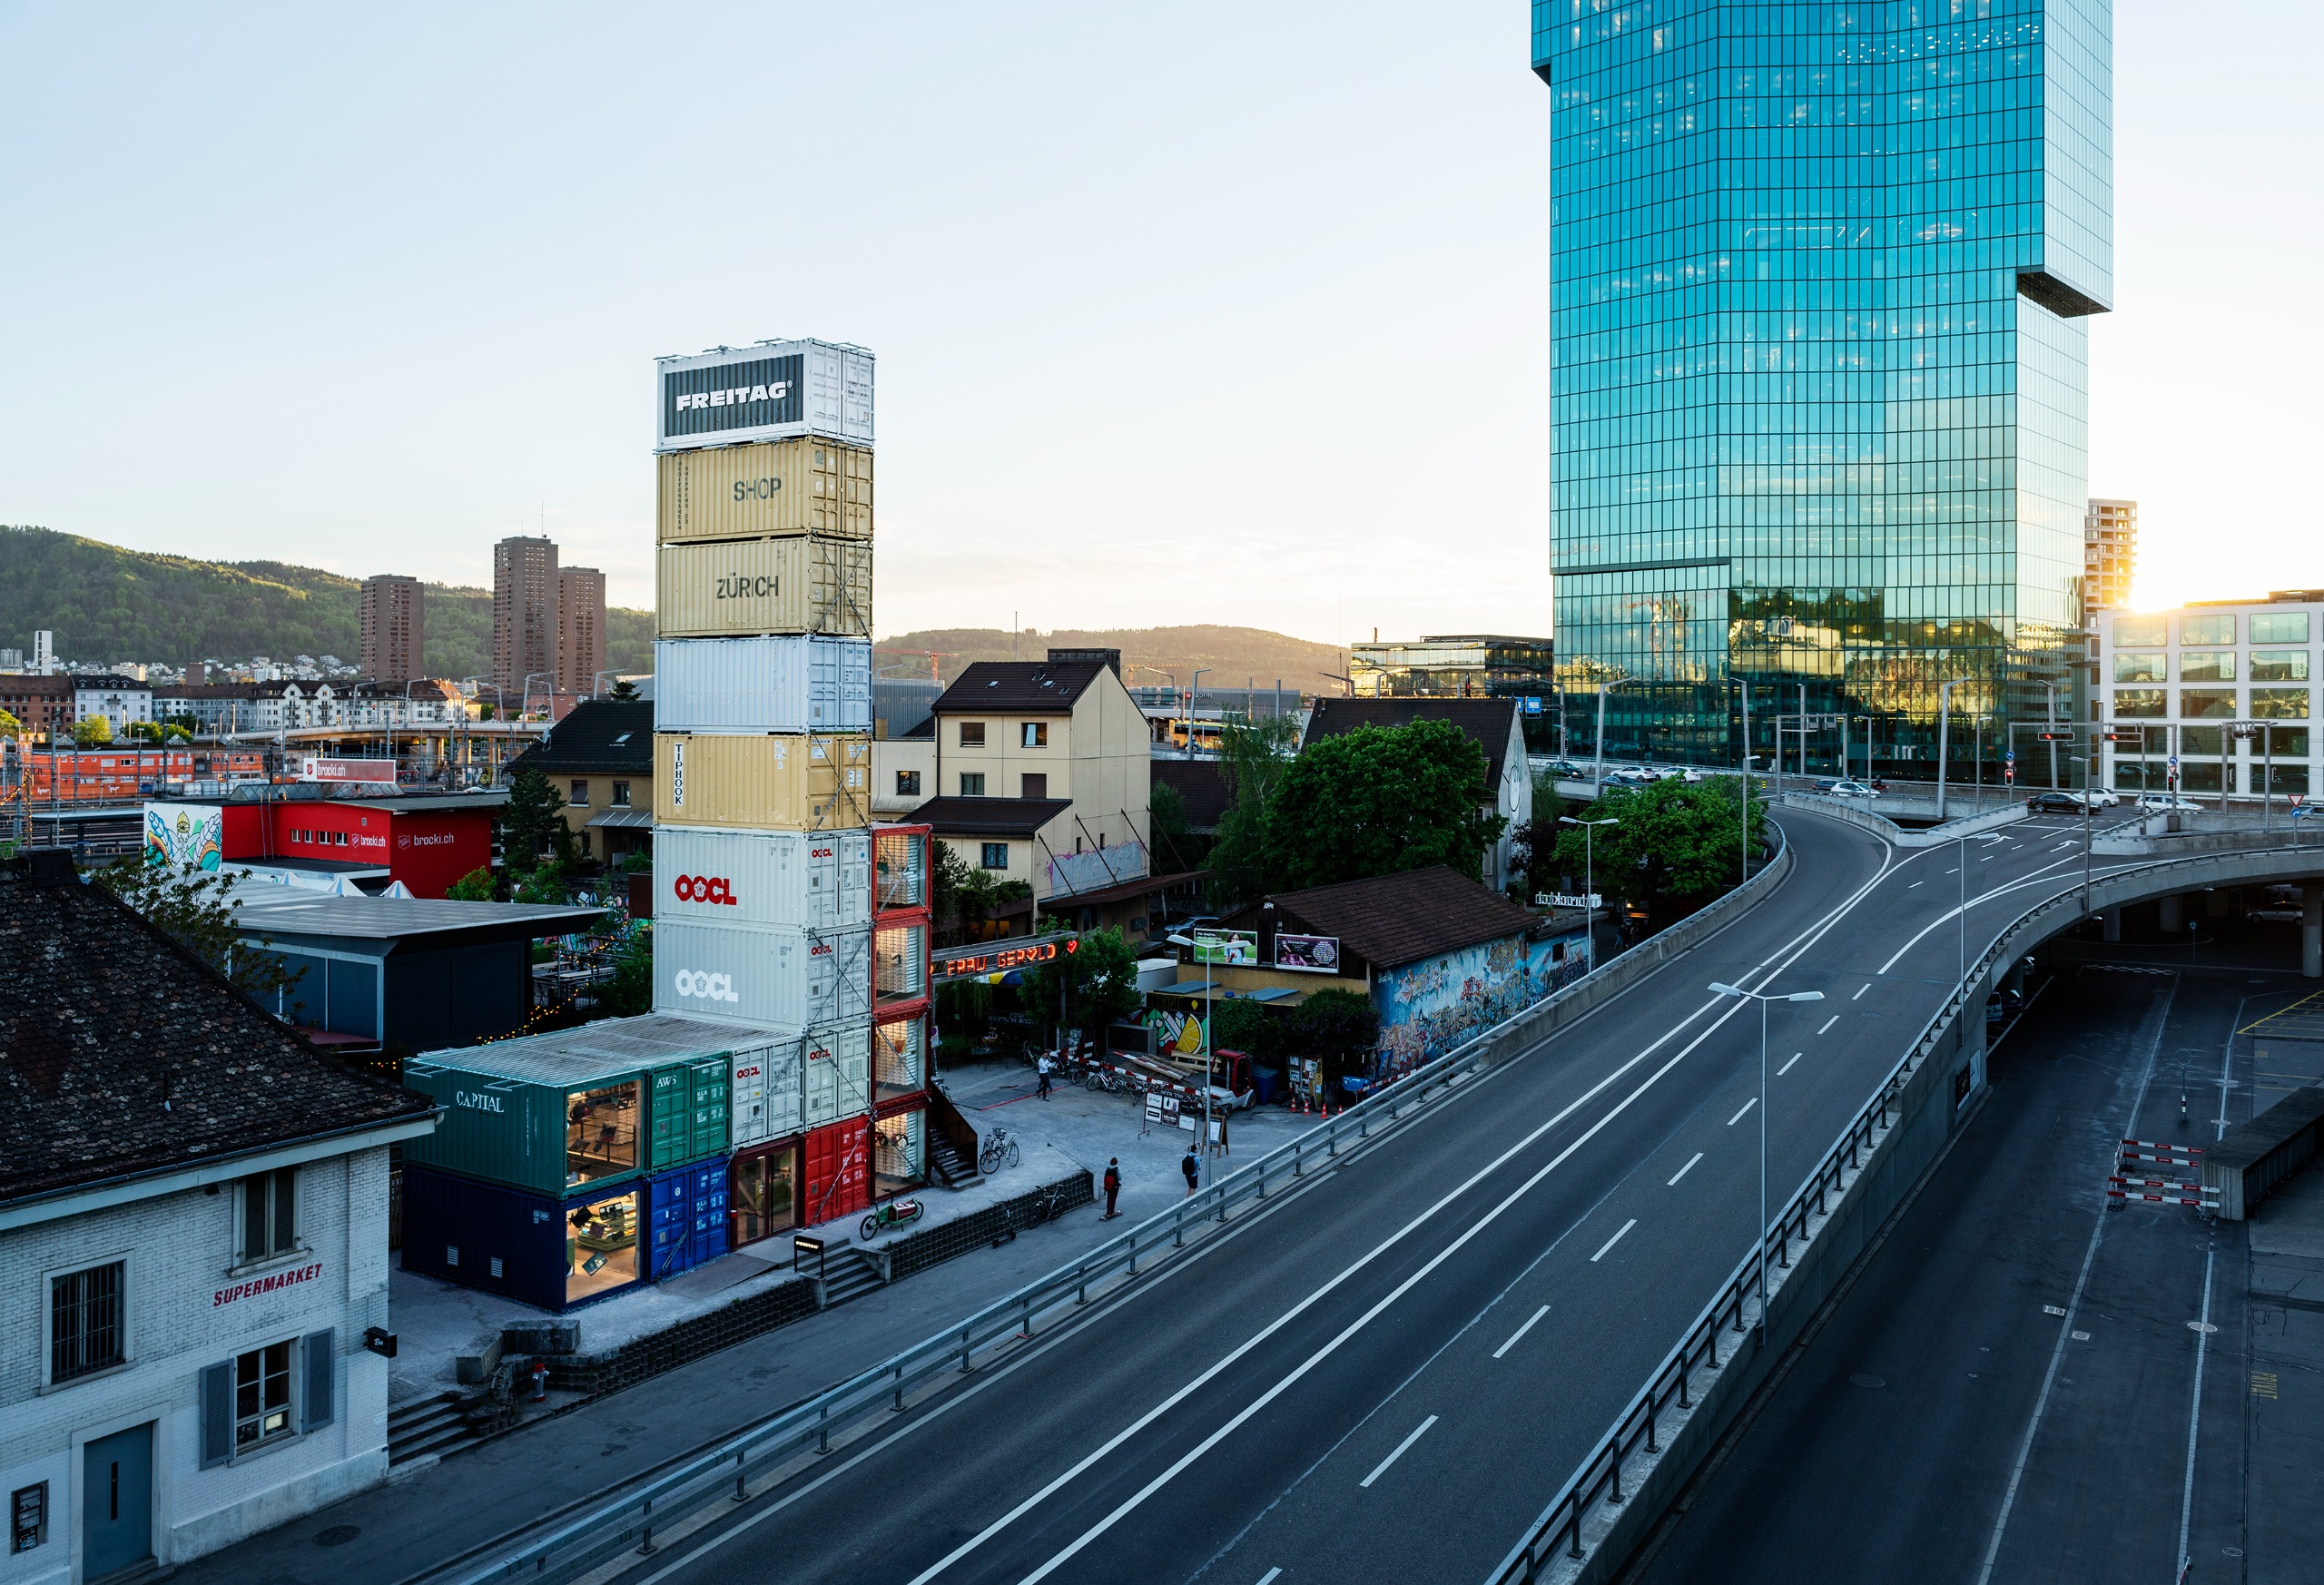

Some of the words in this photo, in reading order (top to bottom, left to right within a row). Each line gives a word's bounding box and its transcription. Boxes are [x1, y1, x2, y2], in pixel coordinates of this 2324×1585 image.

[734, 477, 782, 501] SHOP
[716, 572, 779, 599] ZÜRICH
[318, 763, 345, 777] brocki.ch
[360, 834, 386, 848] brocki.ch
[413, 832, 454, 846] brocki.ch
[812, 848, 832, 858] OOCL
[675, 874, 737, 906] OOCL
[947, 956, 987, 977] FRAU
[675, 969, 739, 1002] OOCL
[655, 1075, 677, 1088] AWS
[737, 1066, 761, 1078] OOCL
[456, 1090, 505, 1113] CAPITAL
[212, 1263, 322, 1307] SUPERMARKET
